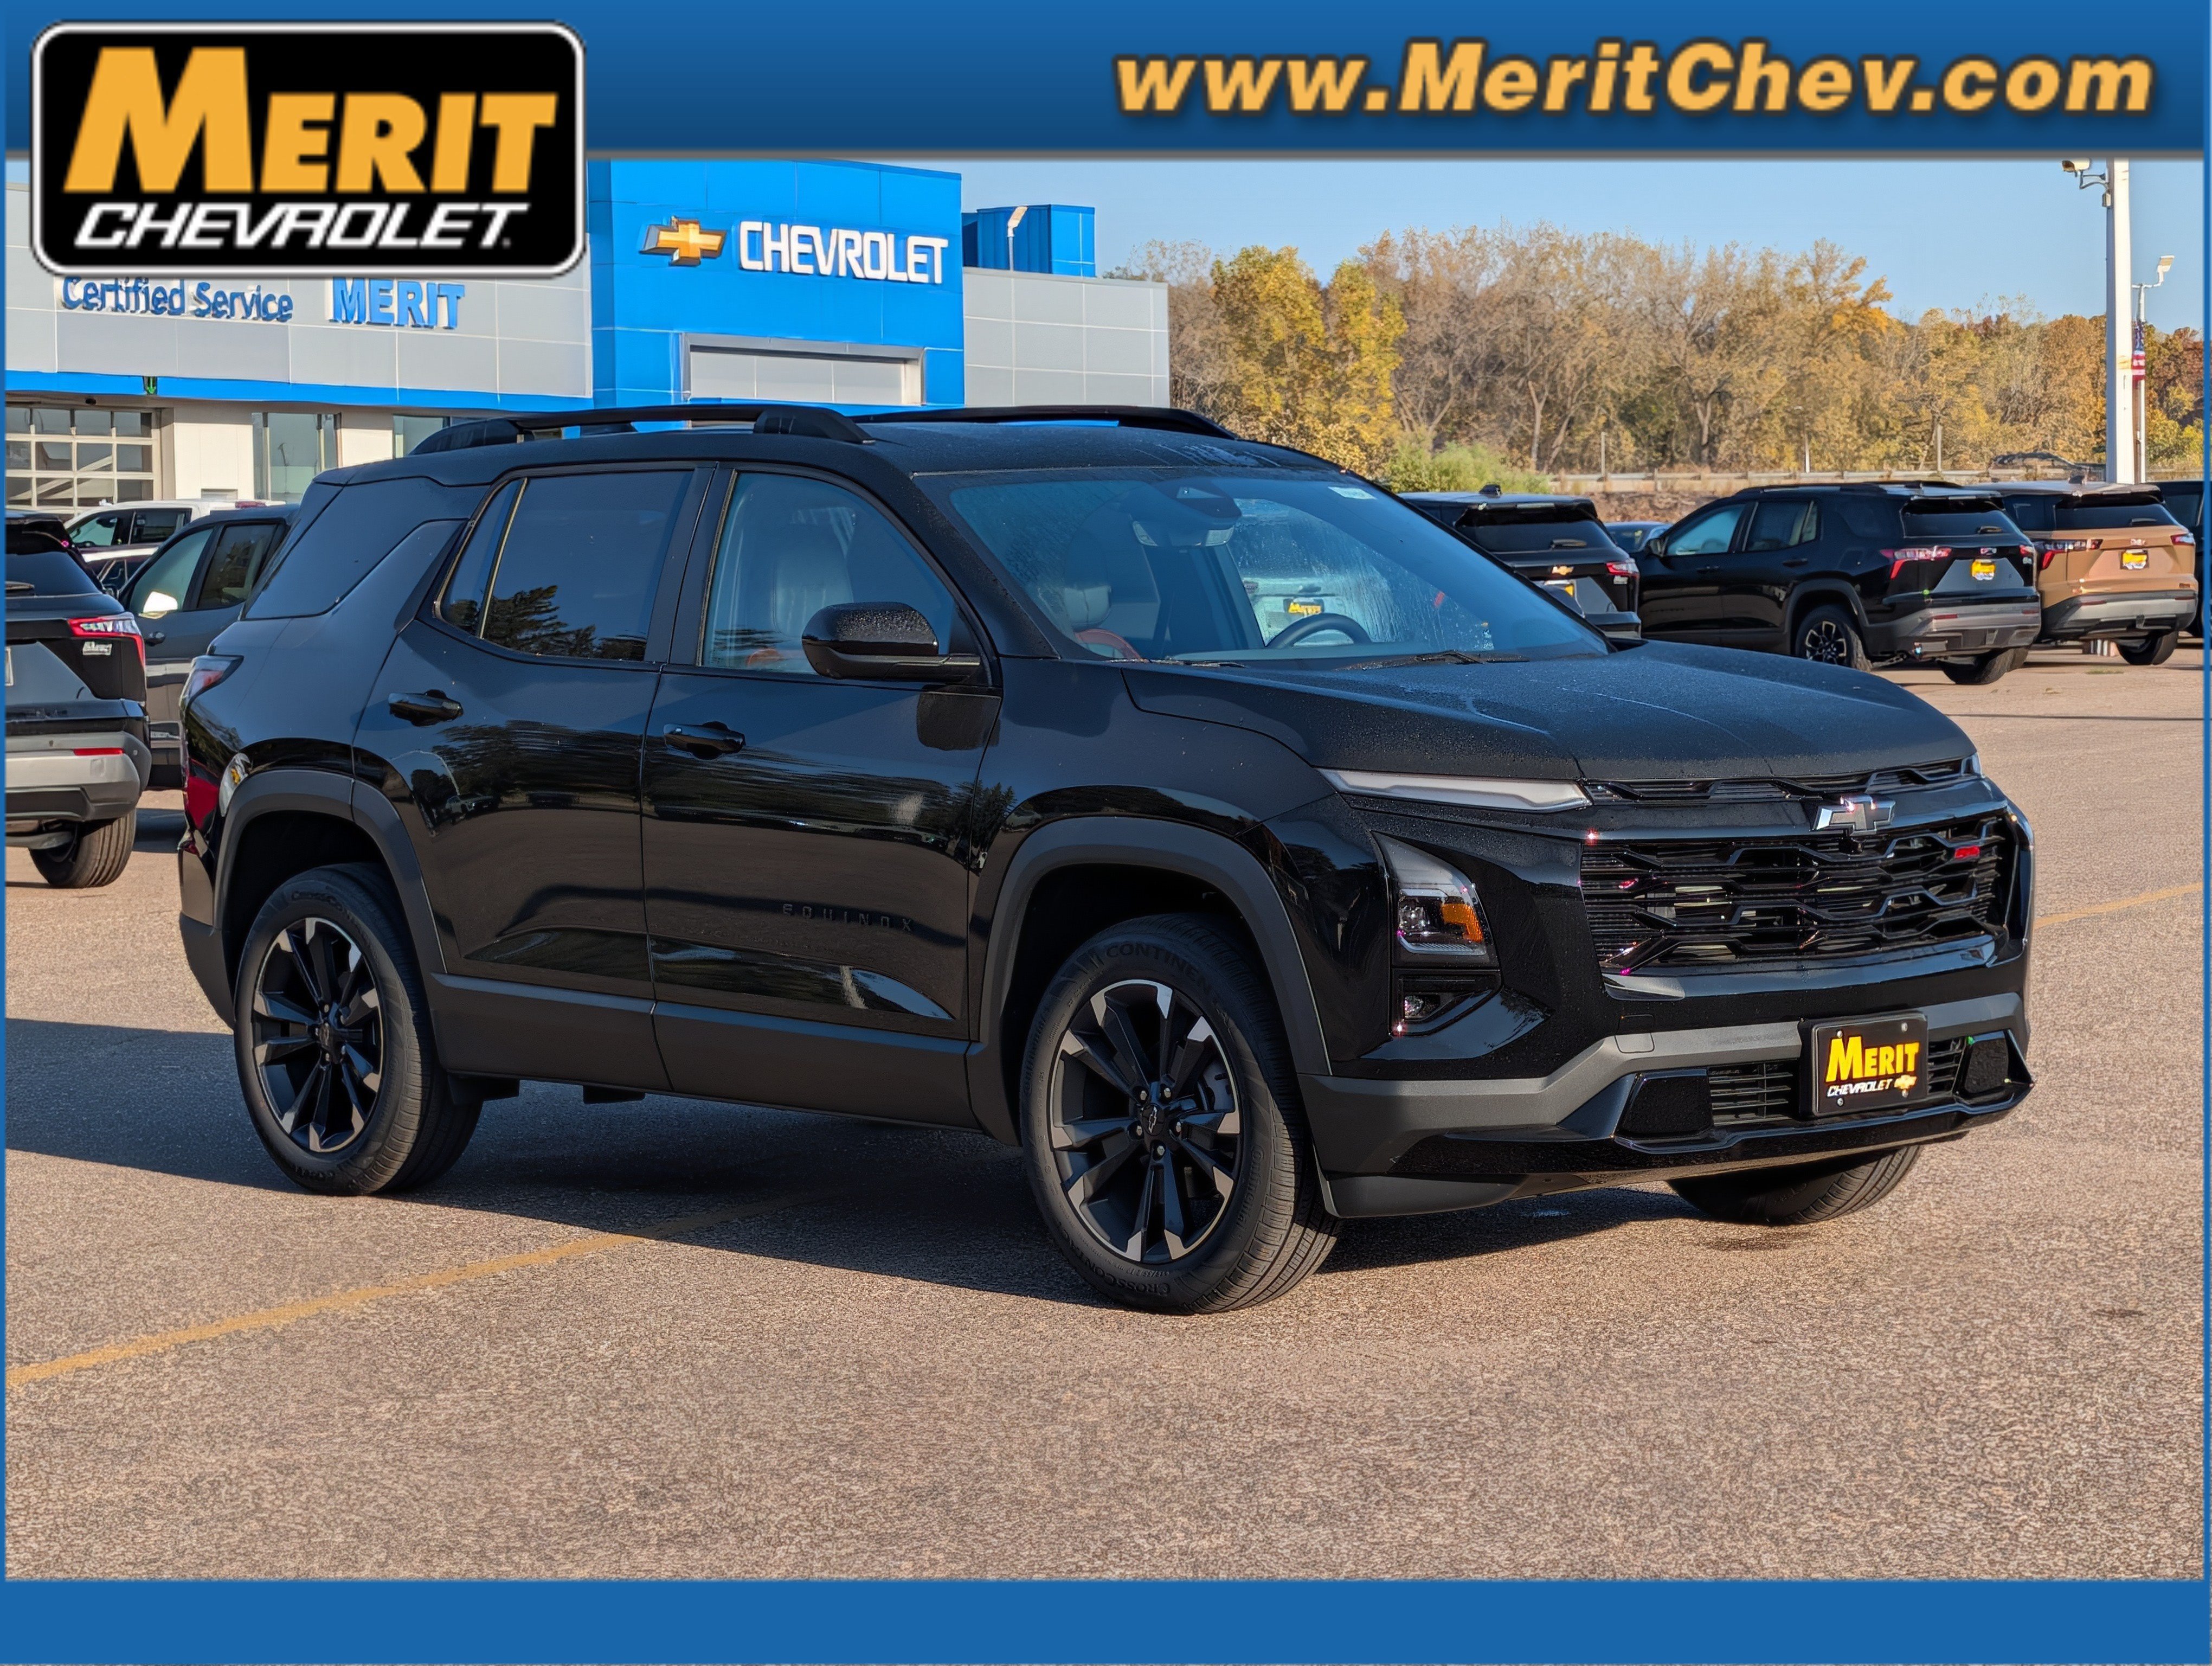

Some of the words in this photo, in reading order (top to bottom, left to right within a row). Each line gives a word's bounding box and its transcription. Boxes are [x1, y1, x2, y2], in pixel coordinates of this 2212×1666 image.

[740, 221, 949, 284] CHEVROLET
[61, 276, 185, 316] Certified
[195, 281, 293, 323] Service
[329, 277, 466, 329] MERIT
[783, 903, 911, 931] EQUINOX
[1825, 1036, 1920, 1082] MERIT
[1827, 1078, 1893, 1097] CHEVROLET
